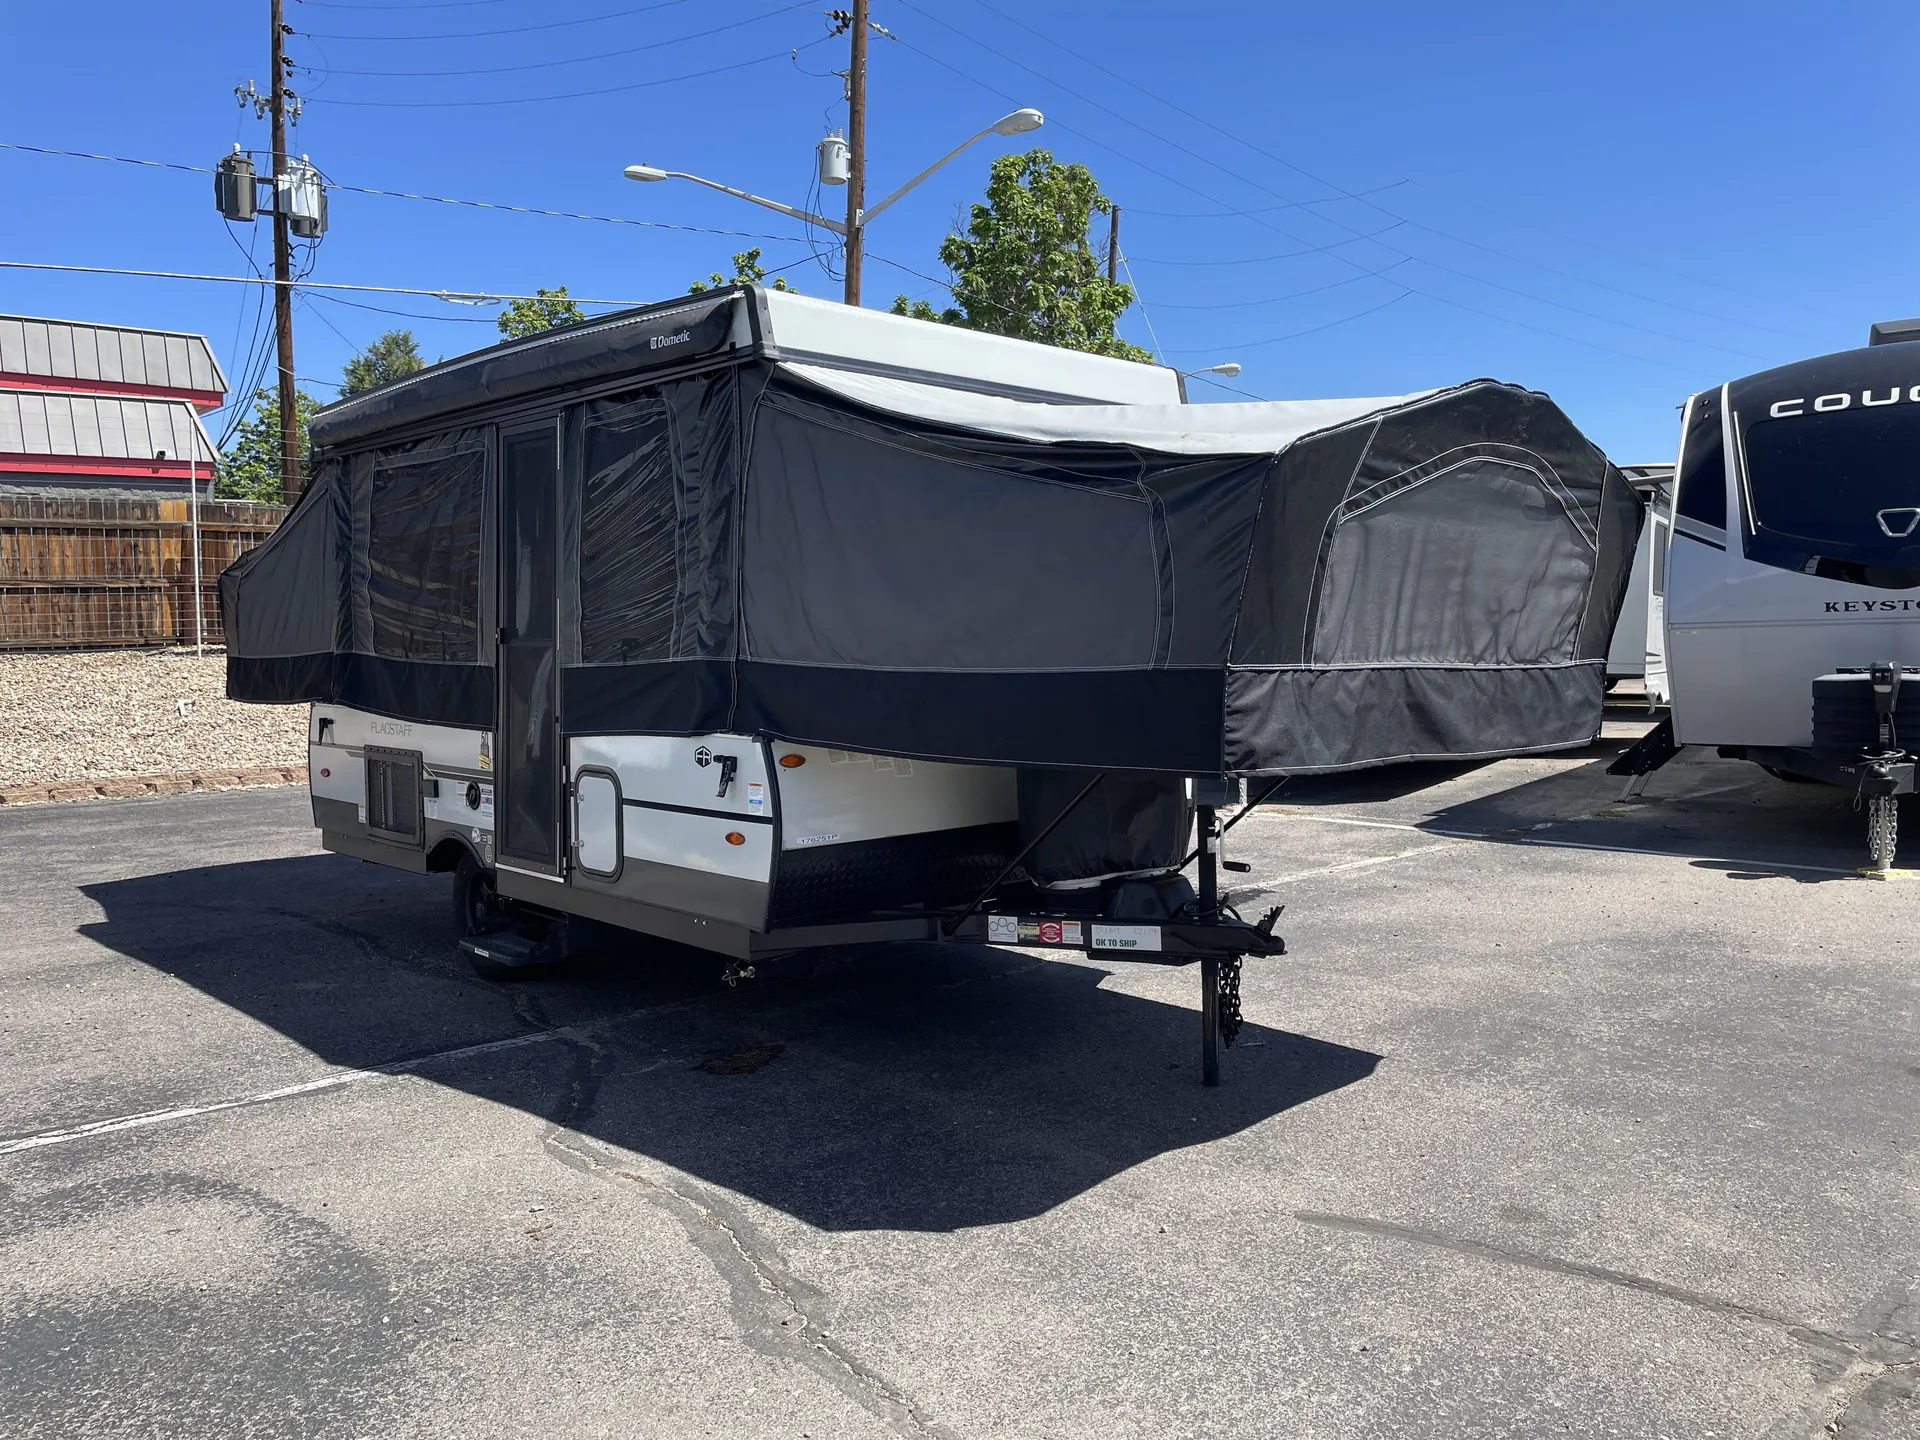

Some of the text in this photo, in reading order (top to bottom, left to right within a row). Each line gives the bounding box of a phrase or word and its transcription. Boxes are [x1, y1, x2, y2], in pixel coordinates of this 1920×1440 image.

[658, 330, 691, 348] Dometic
[1770, 385, 1920, 418] COU
[1823, 599, 1920, 612] KEYST
[370, 721, 414, 737] FLAGSTAFF
[801, 833, 838, 844] 176251P
[1095, 938, 1137, 948] OK TO SHIP
